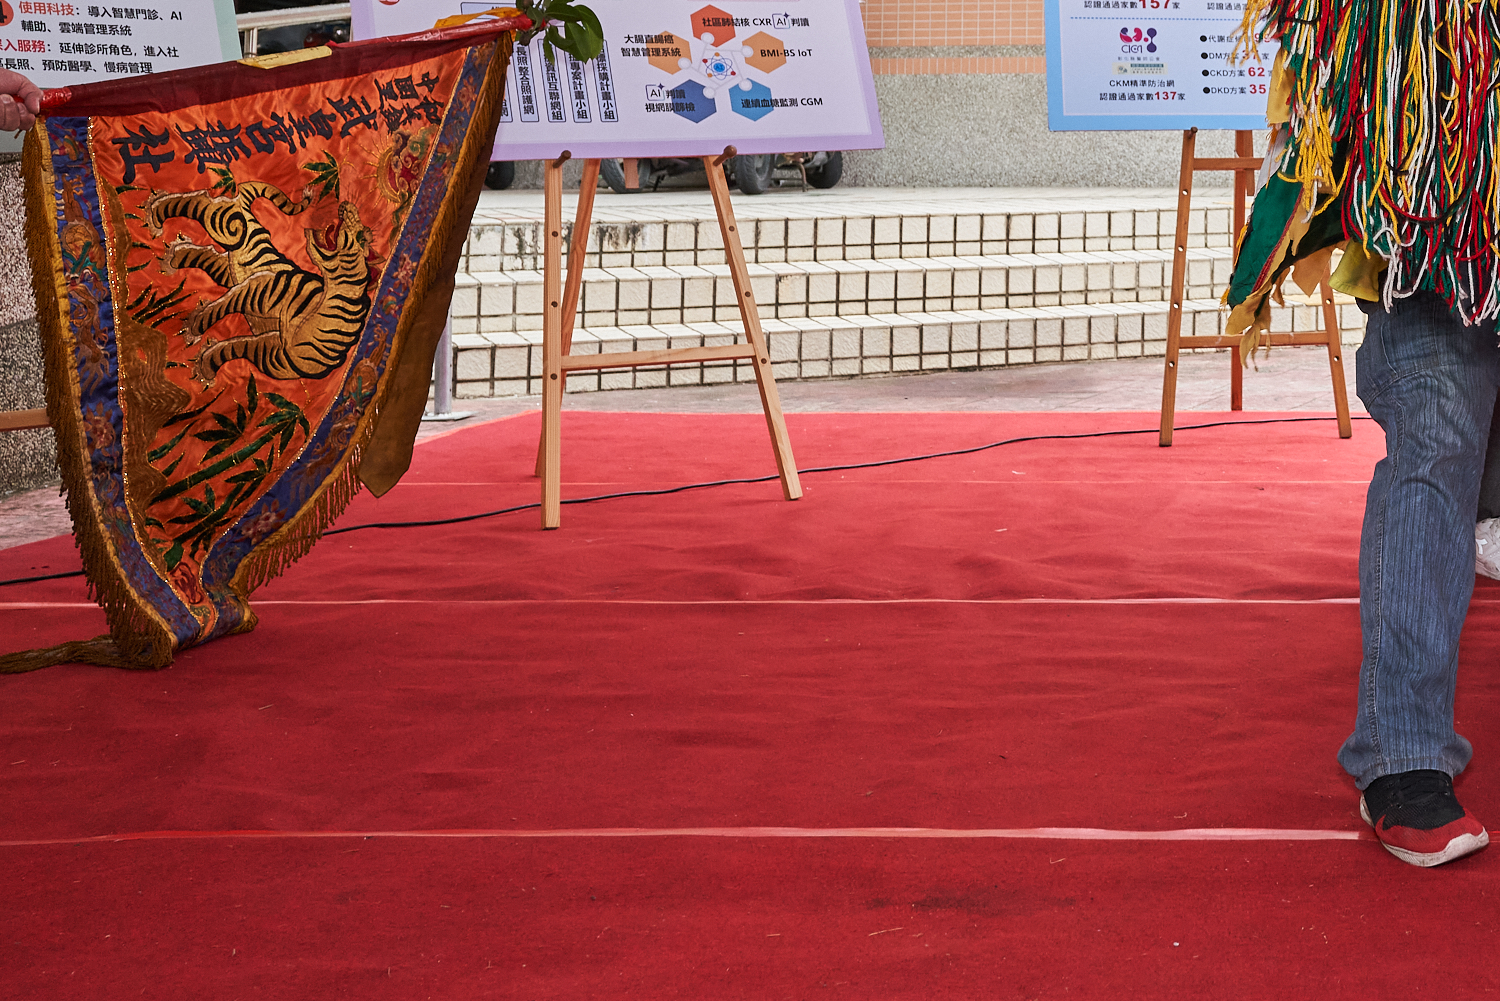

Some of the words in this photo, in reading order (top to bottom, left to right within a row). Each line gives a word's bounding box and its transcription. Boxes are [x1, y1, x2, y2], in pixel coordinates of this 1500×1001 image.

[752, 17, 773, 27] CXR
[775, 17, 788, 27] AI
[623, 34, 675, 45] 大腸直腸癌
[620, 47, 682, 58] 智慧管理系統
[760, 48, 796, 58] BMI-BS
[1247, 66, 1266, 77] 62
[1109, 79, 1175, 88] CKM精準防治網
[1249, 83, 1267, 94] 35
[649, 89, 662, 99] AI
[800, 97, 824, 107] CGM
